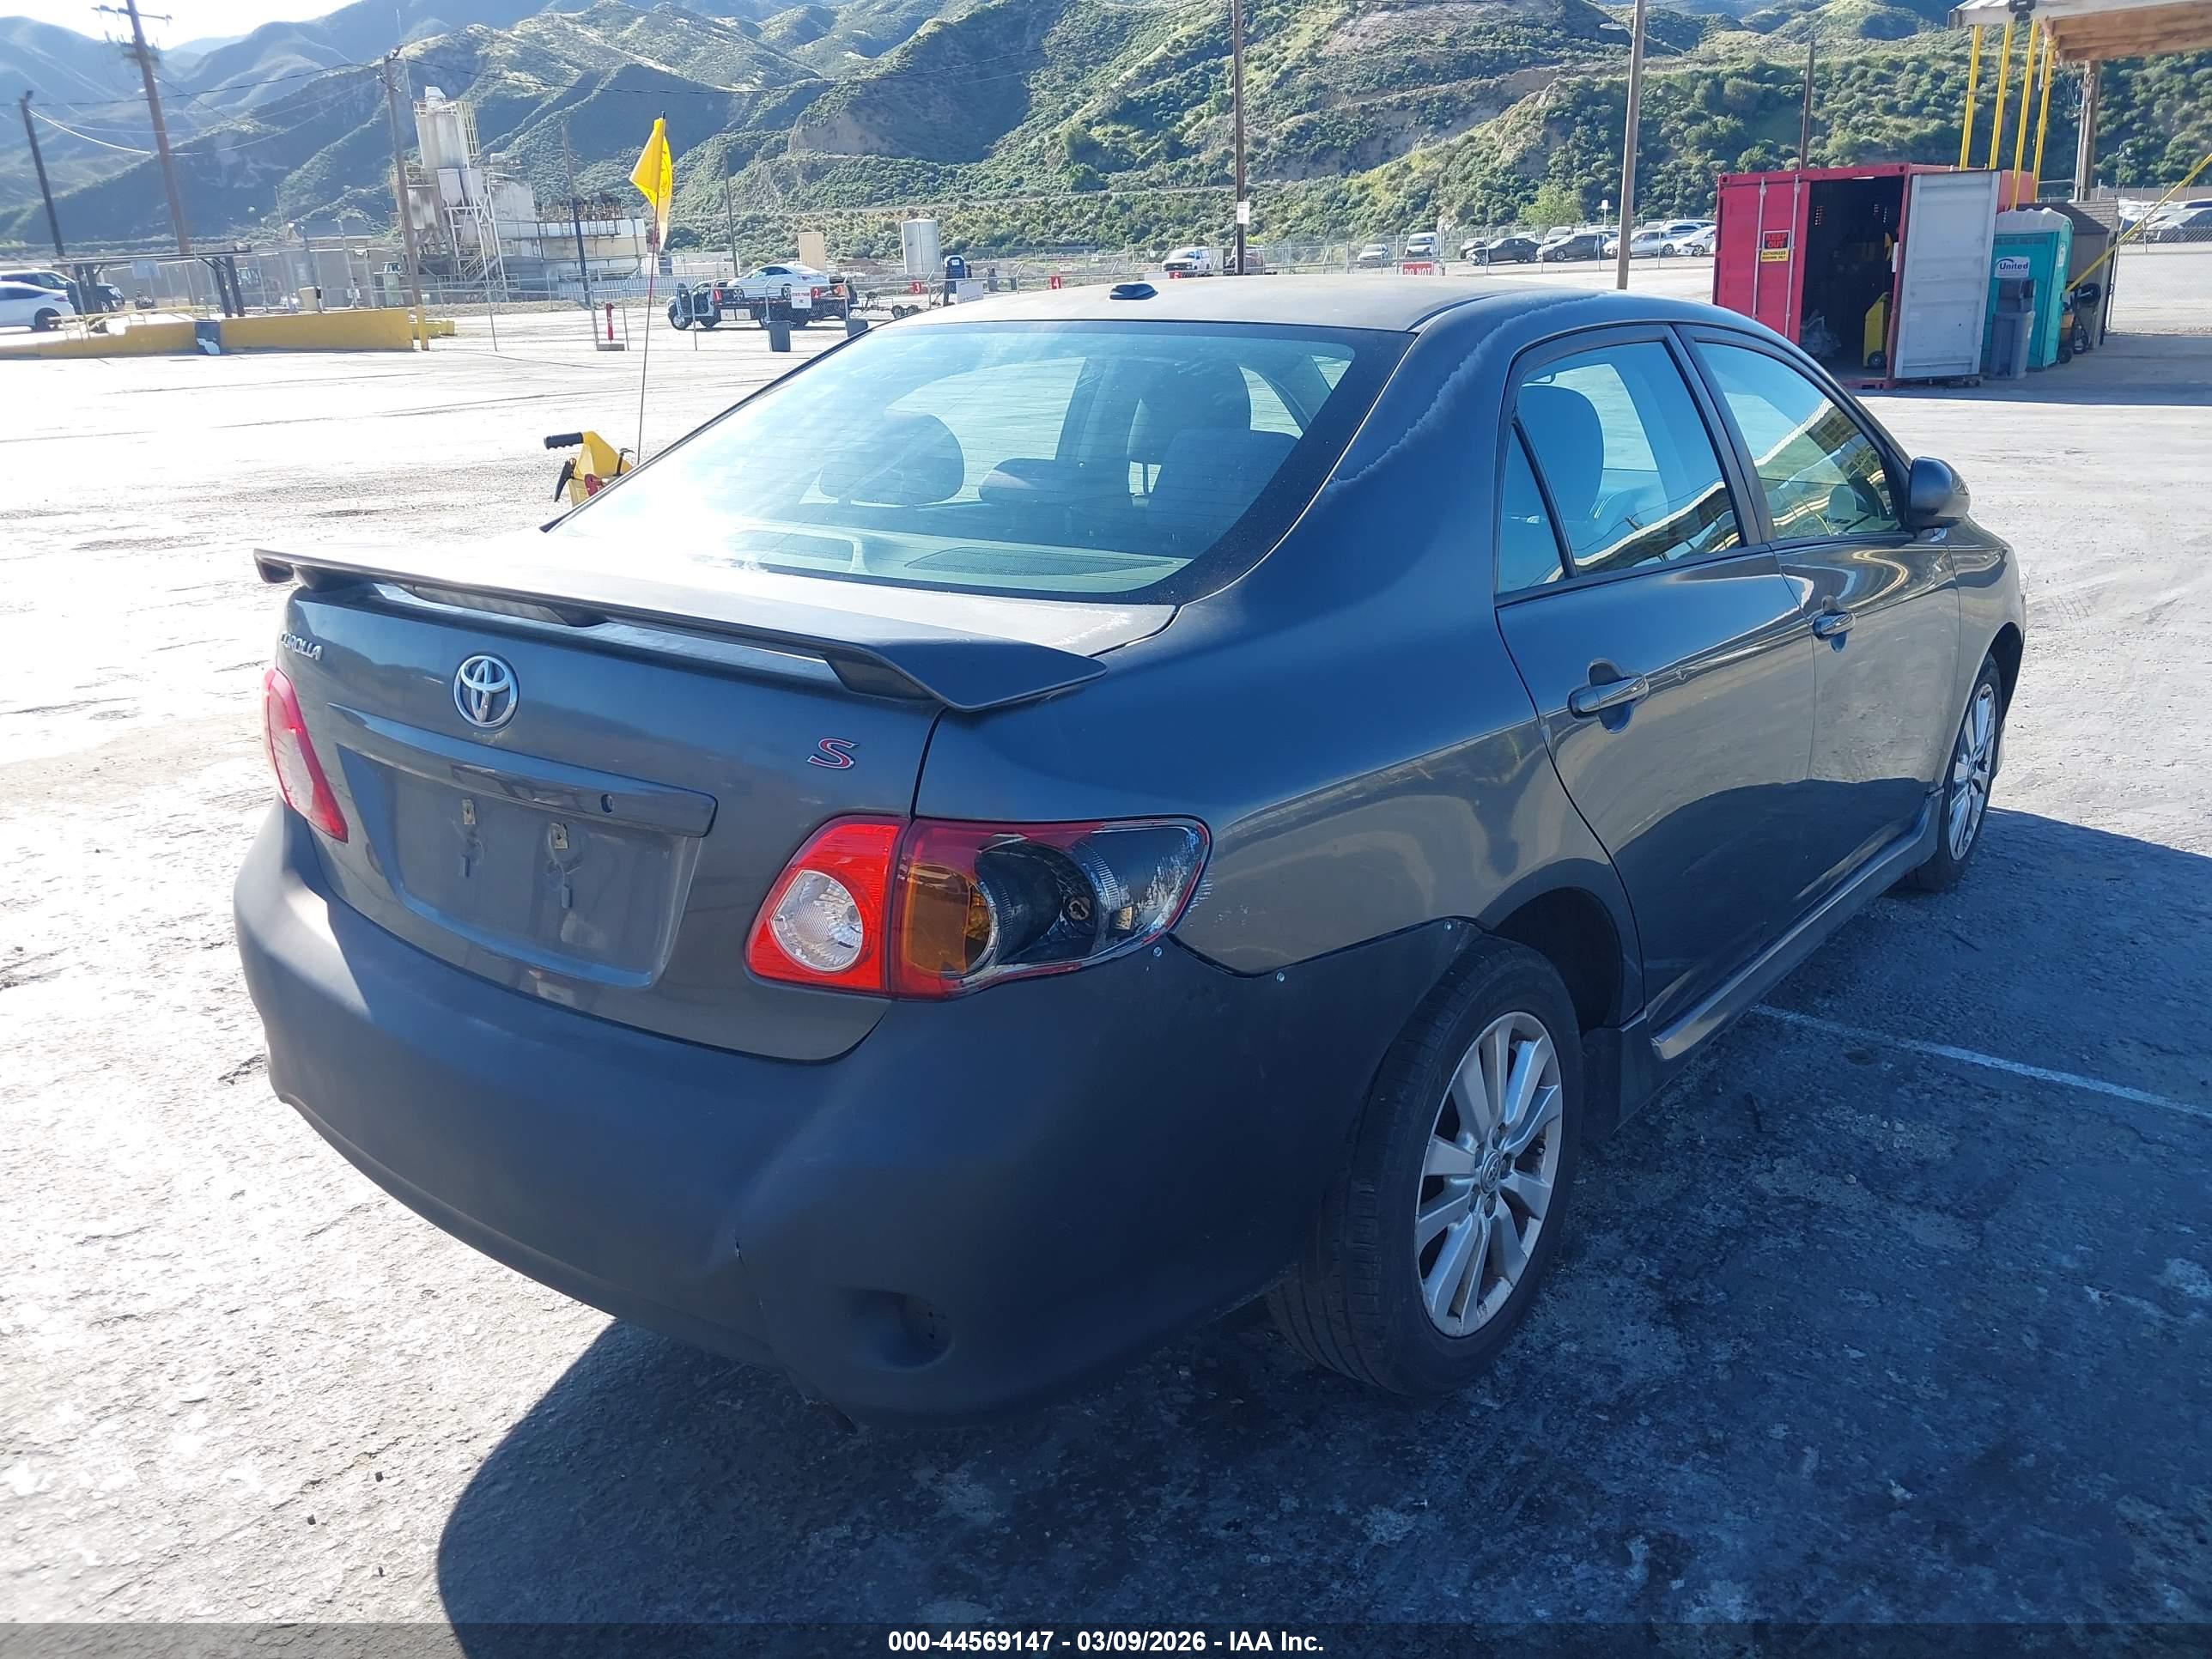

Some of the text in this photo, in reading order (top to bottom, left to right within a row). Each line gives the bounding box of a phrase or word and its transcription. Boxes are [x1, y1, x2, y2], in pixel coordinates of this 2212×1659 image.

[914, 283, 921, 294] 3
[1053, 279, 1060, 289] 4
[813, 288, 819, 299] 2
[807, 738, 860, 769] S
